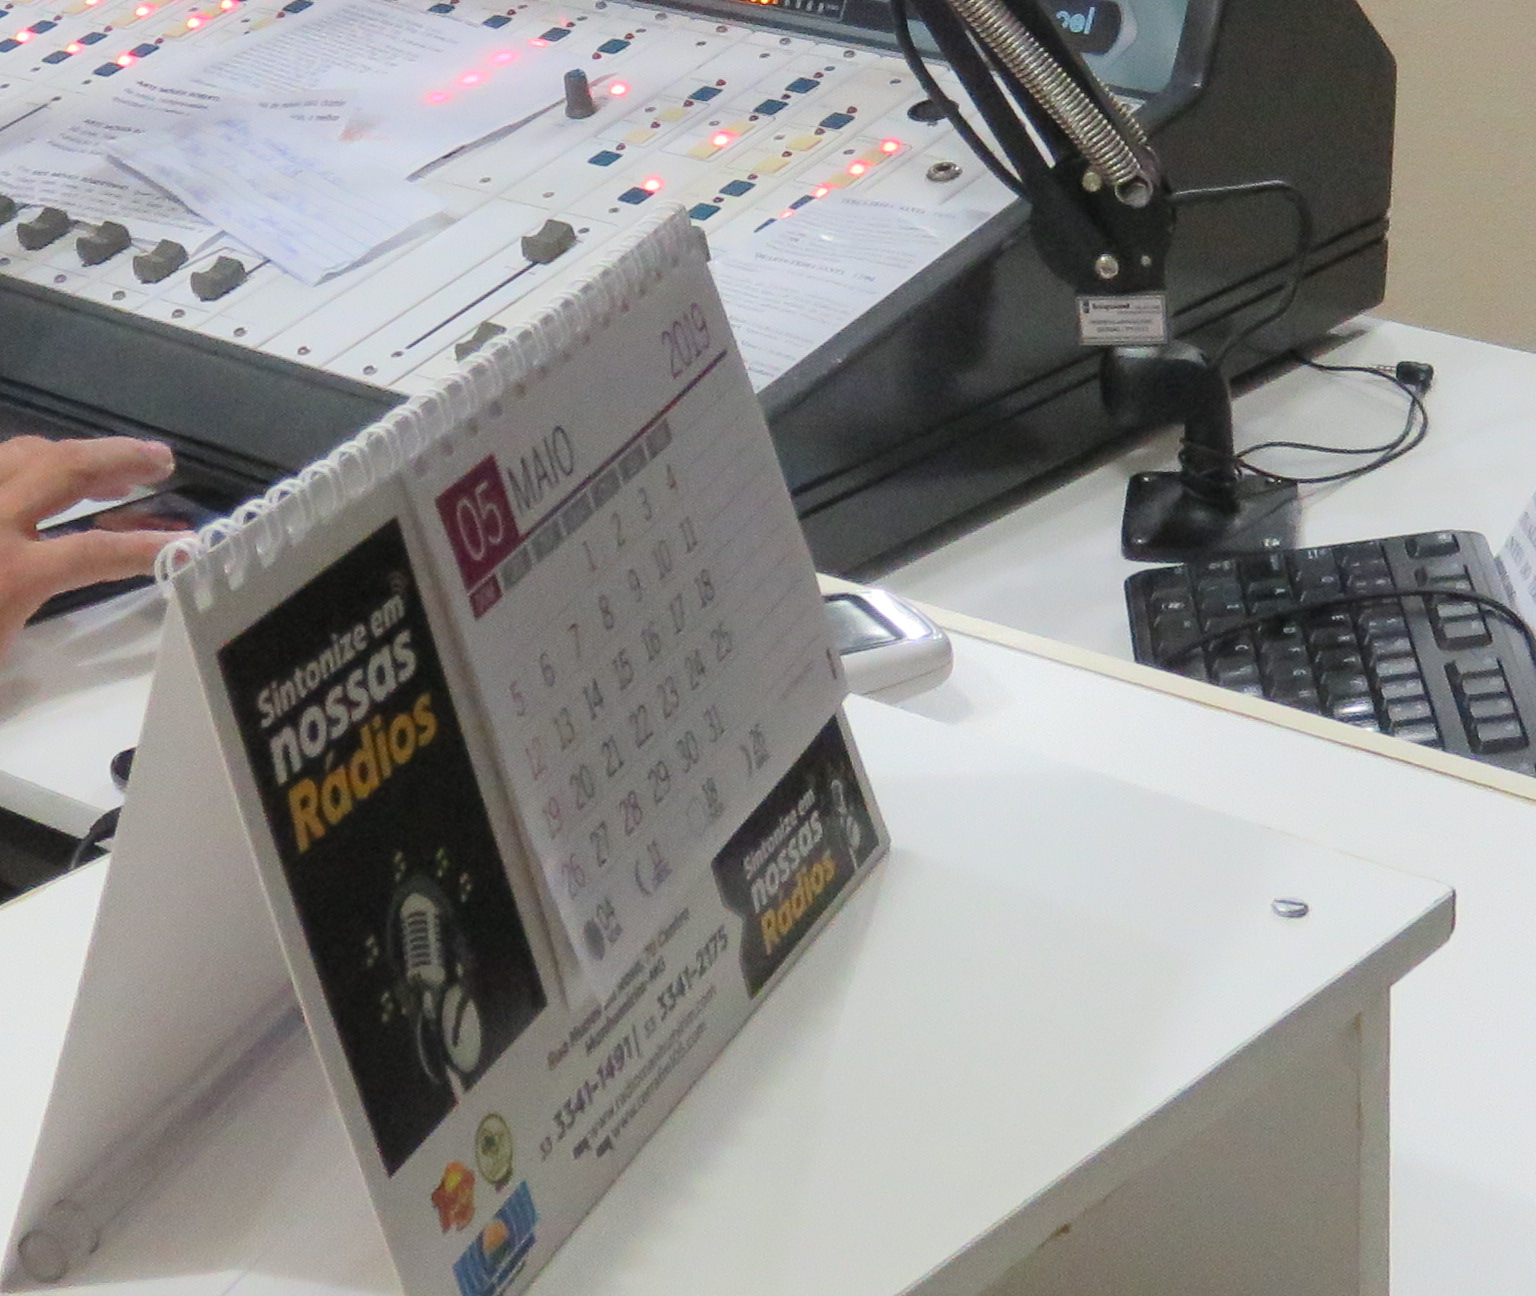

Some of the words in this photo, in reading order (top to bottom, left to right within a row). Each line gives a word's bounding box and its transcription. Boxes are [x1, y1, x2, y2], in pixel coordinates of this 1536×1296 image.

[661, 302, 710, 379] 2019
[456, 479, 503, 562] 05
[507, 425, 575, 516] MAIO
[582, 540, 598, 572] 1
[613, 512, 626, 547] 2
[638, 487, 652, 521] 3
[666, 464, 678, 490] 4
[257, 624, 367, 728] Sintonize
[370, 595, 405, 639] em
[509, 680, 526, 717] 5
[540, 652, 556, 687] 6
[568, 622, 581, 657] 7
[598, 594, 614, 630] 8
[627, 569, 643, 602] 9
[654, 539, 672, 581] 10
[679, 516, 698, 553] 11
[525, 736, 545, 781] 12
[554, 707, 575, 751] 13
[583, 678, 604, 720] 14
[613, 648, 634, 691] 15
[641, 621, 662, 662] 16
[670, 592, 685, 635] 17
[695, 569, 714, 608] 18
[269, 629, 417, 786] nossas
[288, 693, 438, 853] Rádios
[544, 796, 562, 839] 19
[569, 764, 595, 810] 20
[601, 735, 624, 778] 21
[629, 704, 654, 748] 22
[657, 676, 679, 718] 23
[686, 649, 706, 691] 24
[710, 623, 732, 663] 25
[562, 852, 585, 900] 26
[589, 821, 609, 867] 27
[619, 790, 643, 837] 28
[647, 760, 670, 804] 29
[676, 730, 699, 773] 30
[704, 705, 725, 743] 31
[743, 807, 798, 880] Sintonize
[797, 789, 815, 814] em
[750, 810, 823, 914] nossas
[760, 852, 836, 955] Rádios
[657, 925, 728, 1022] 3341-2175
